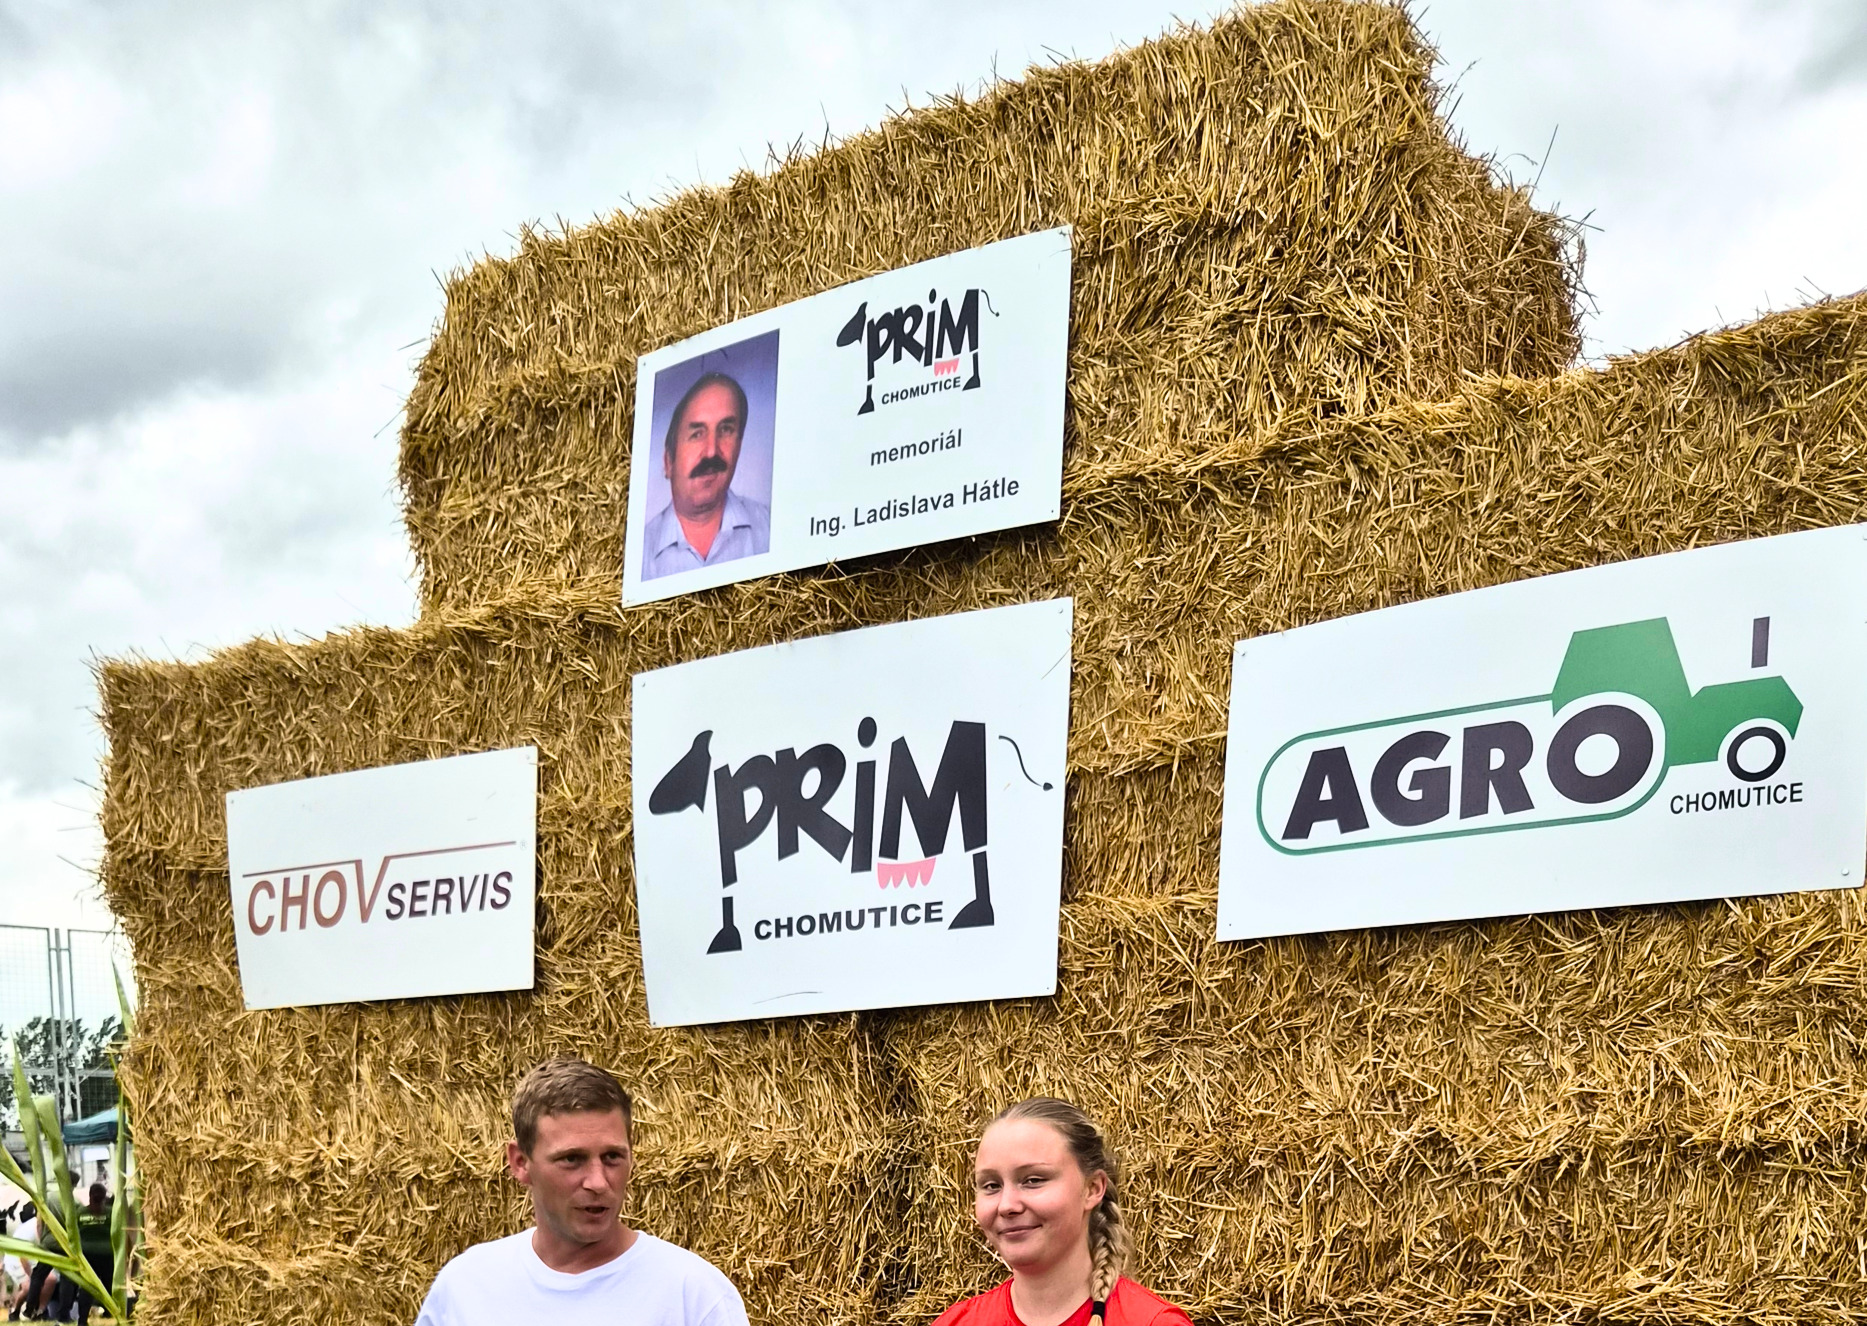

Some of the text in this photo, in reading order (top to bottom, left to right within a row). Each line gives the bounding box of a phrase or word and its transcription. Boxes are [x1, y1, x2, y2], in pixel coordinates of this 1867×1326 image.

[881, 376, 961, 405] CHOMUTICE
[870, 428, 963, 466] memoriál
[810, 476, 1019, 537] Ing. Ladislava Hátle
[1281, 704, 1654, 841] AGRO
[1670, 782, 1804, 816] CHOMUTICE
[754, 901, 944, 940] CHOMUTICE
